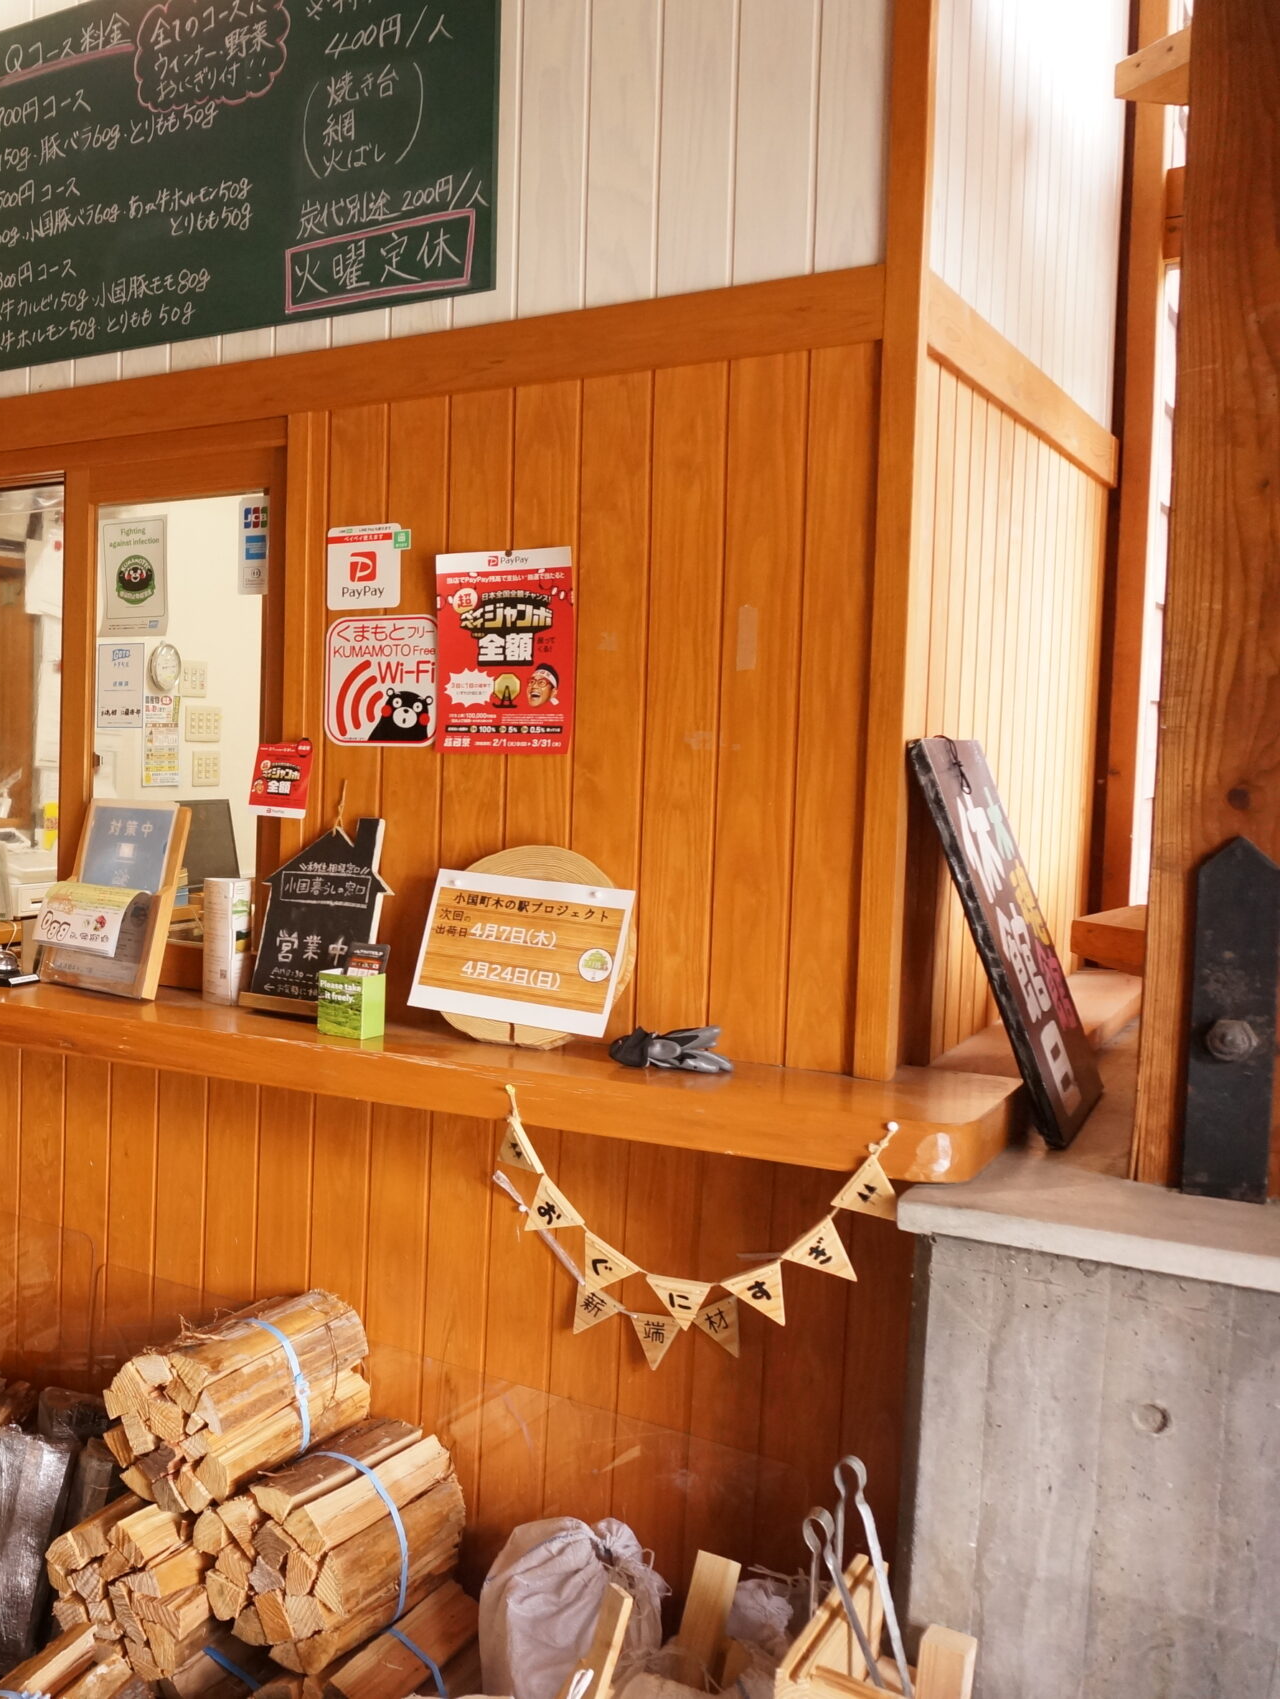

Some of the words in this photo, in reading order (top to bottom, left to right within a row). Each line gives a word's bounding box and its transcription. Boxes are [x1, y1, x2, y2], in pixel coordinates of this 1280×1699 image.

[327, 64, 400, 108] 焼き台
[296, 228, 461, 298] 火曜定休
[109, 540, 131, 549] against
[133, 537, 159, 546] infection
[121, 527, 146, 536] Fighting
[500, 556, 528, 565] PayPay
[342, 585, 385, 599] PayPay
[333, 643, 412, 658] KUMAMOTO
[413, 645, 437, 655] Free
[479, 633, 533, 662] 全額
[377, 660, 436, 684] Wi-Fi
[285, 876, 366, 897] 小国暮らしの窓口
[453, 892, 609, 923] 小国町木の駅プロジェクト
[435, 925, 468, 938] 出荷日
[470, 922, 557, 948] 4月7日(木)
[276, 929, 348, 966] 営業中
[320, 980, 343, 990] Please
[345, 983, 361, 992] take
[461, 960, 561, 990] 4月24日(日)
